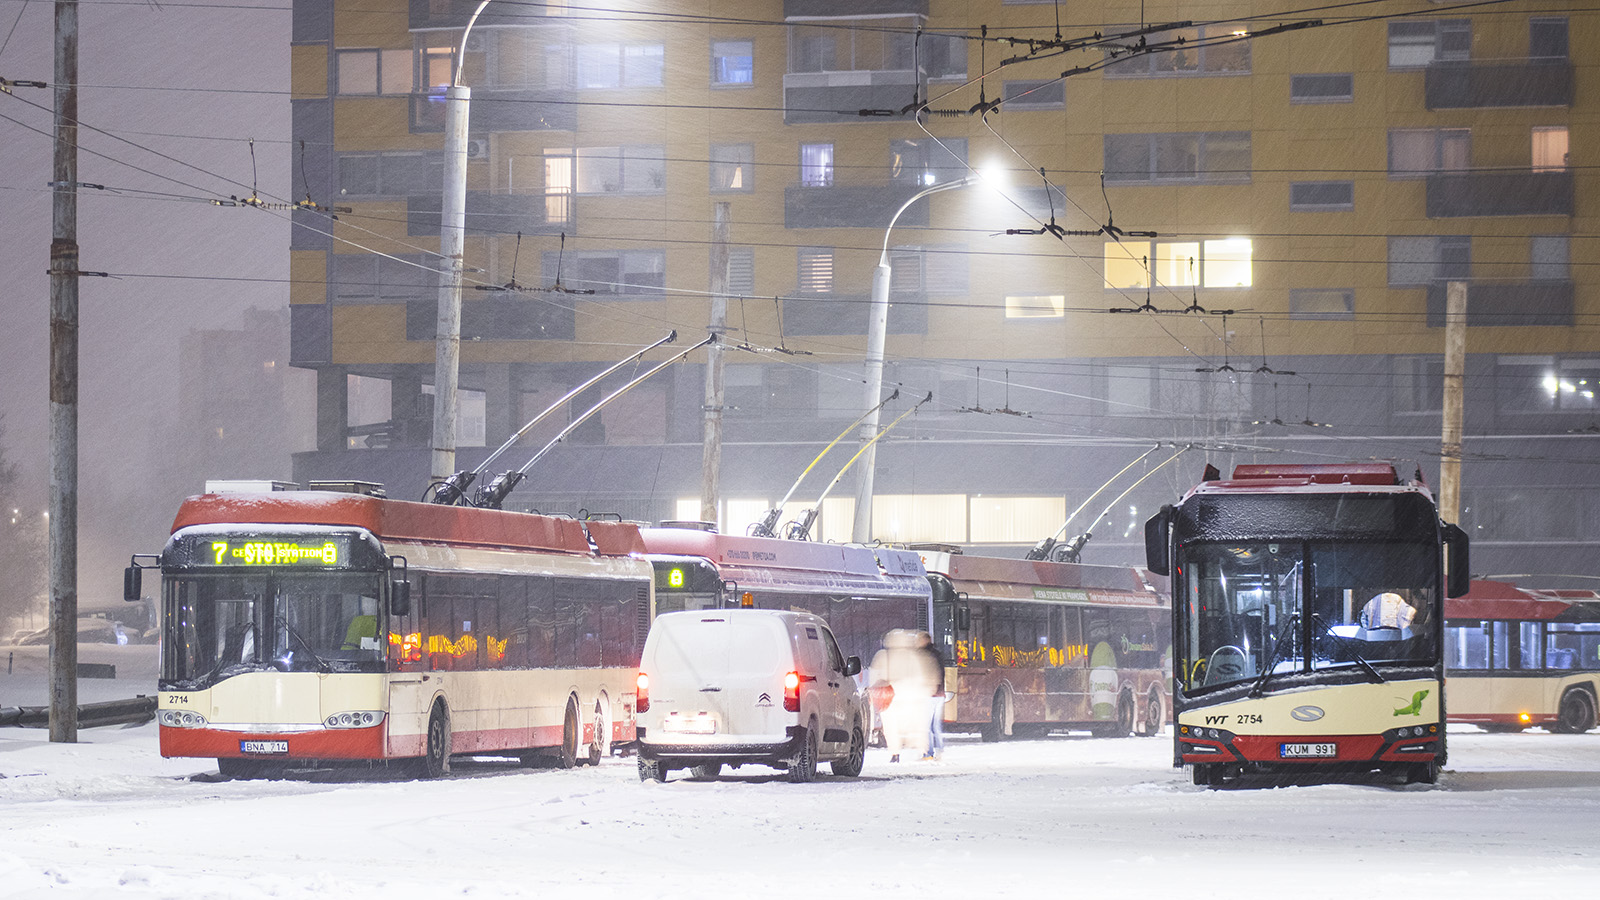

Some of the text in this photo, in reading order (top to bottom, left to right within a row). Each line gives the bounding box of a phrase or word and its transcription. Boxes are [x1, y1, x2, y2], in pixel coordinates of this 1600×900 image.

[213, 542, 227, 563] 7
[169, 695, 188, 704] 2714
[1205, 714, 1263, 725] VVT 2754
[246, 743, 286, 751] BNA 714
[1286, 745, 1334, 754] KUM 991
